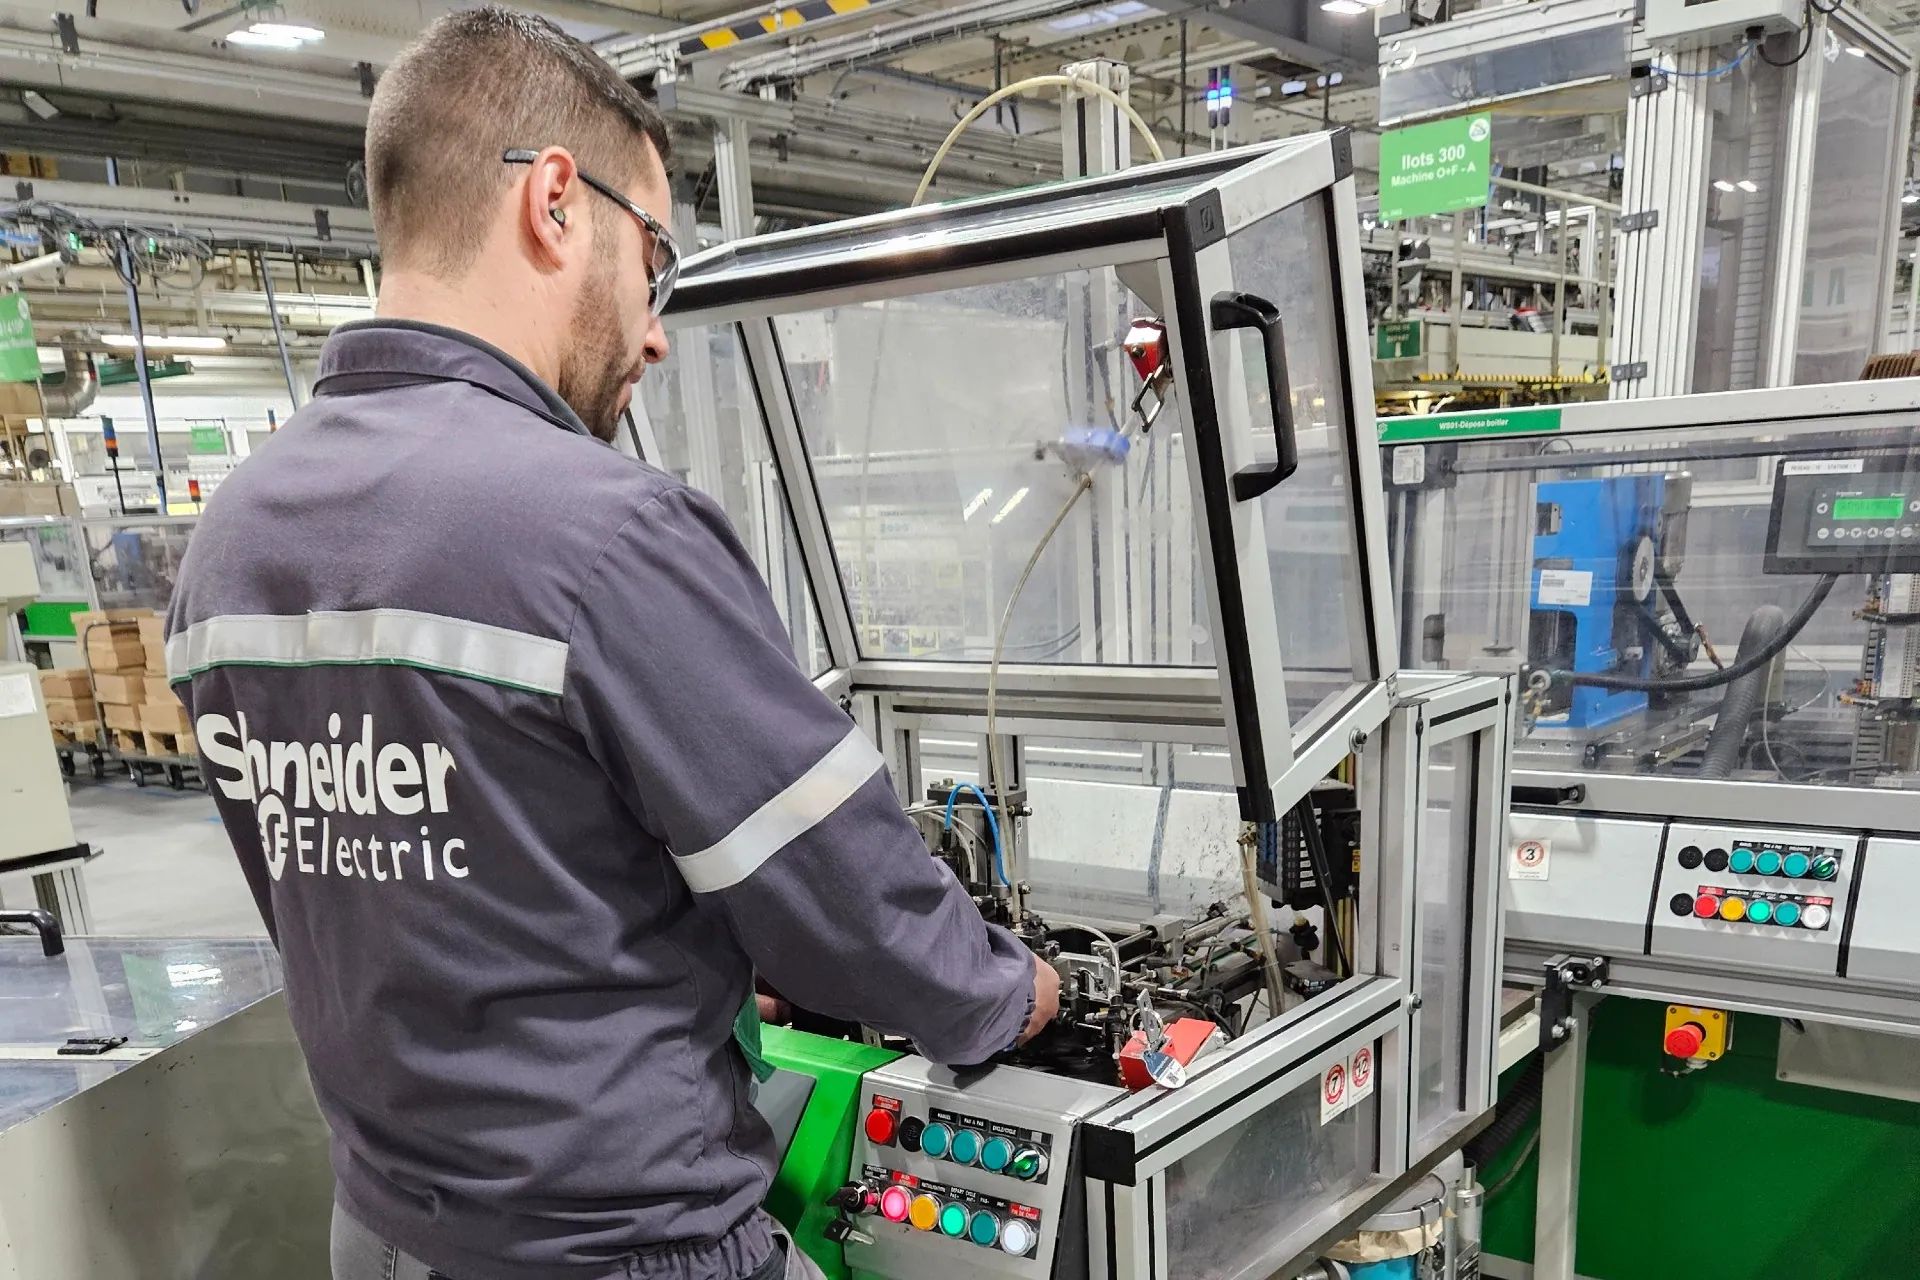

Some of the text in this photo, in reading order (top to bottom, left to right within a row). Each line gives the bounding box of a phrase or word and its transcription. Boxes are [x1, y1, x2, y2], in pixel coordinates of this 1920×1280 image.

[1401, 144, 1466, 170] Ilots 300
[1391, 171, 1435, 187] Machine
[1467, 161, 1476, 173] A
[196, 711, 457, 815] Shneider
[294, 816, 469, 882] Electric
[1526, 848, 1536, 861] 3
[1331, 1075, 1339, 1093] 7
